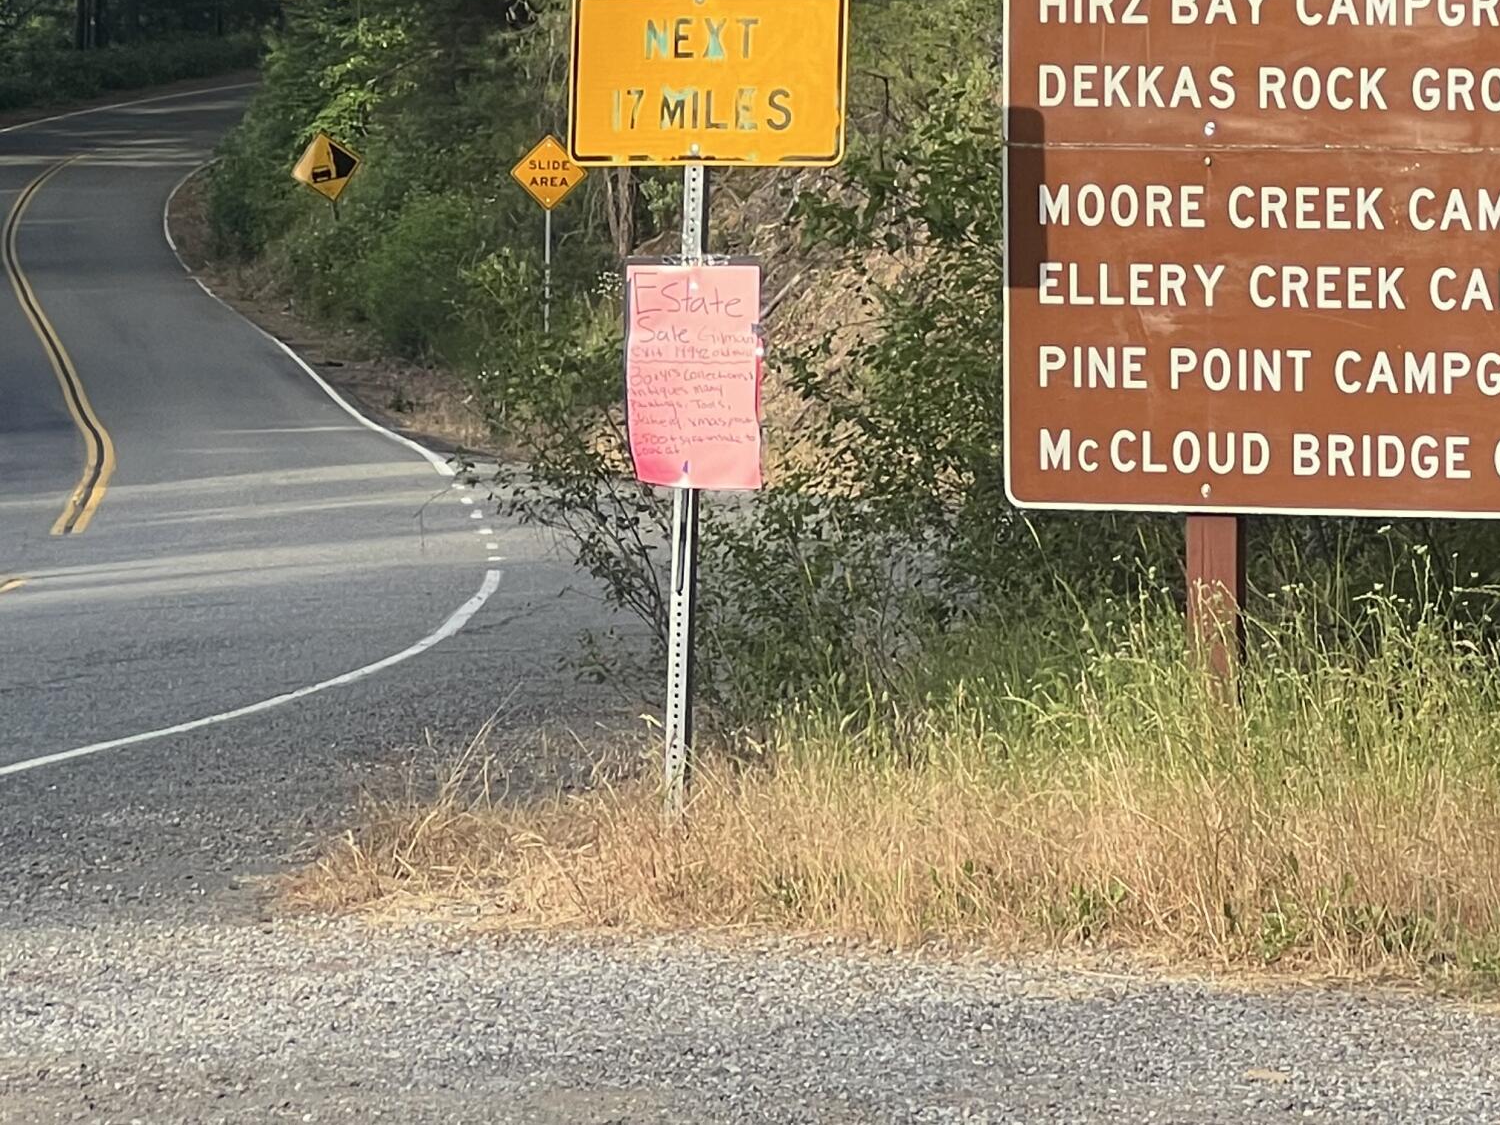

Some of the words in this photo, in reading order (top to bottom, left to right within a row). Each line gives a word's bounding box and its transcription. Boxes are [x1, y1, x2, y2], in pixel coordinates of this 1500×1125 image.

[645, 18, 759, 59] NEXT
[611, 89, 644, 131] 17
[660, 85, 793, 130] MILES
[1039, 65, 1235, 109] DEKKAS
[1260, 66, 1387, 110] ROCK
[529, 160, 570, 170] SLIDE
[530, 177, 569, 187] AREA
[1040, 184, 1205, 227] MOORE
[1229, 186, 1384, 230] CREEK
[1039, 262, 1225, 307] ELLERY
[1250, 265, 1405, 309] CREEK
[637, 316, 689, 343] Sale
[1040, 346, 1147, 389] PINE
[1171, 348, 1311, 392] POINT
[1294, 434, 1471, 479] BRIDGE
